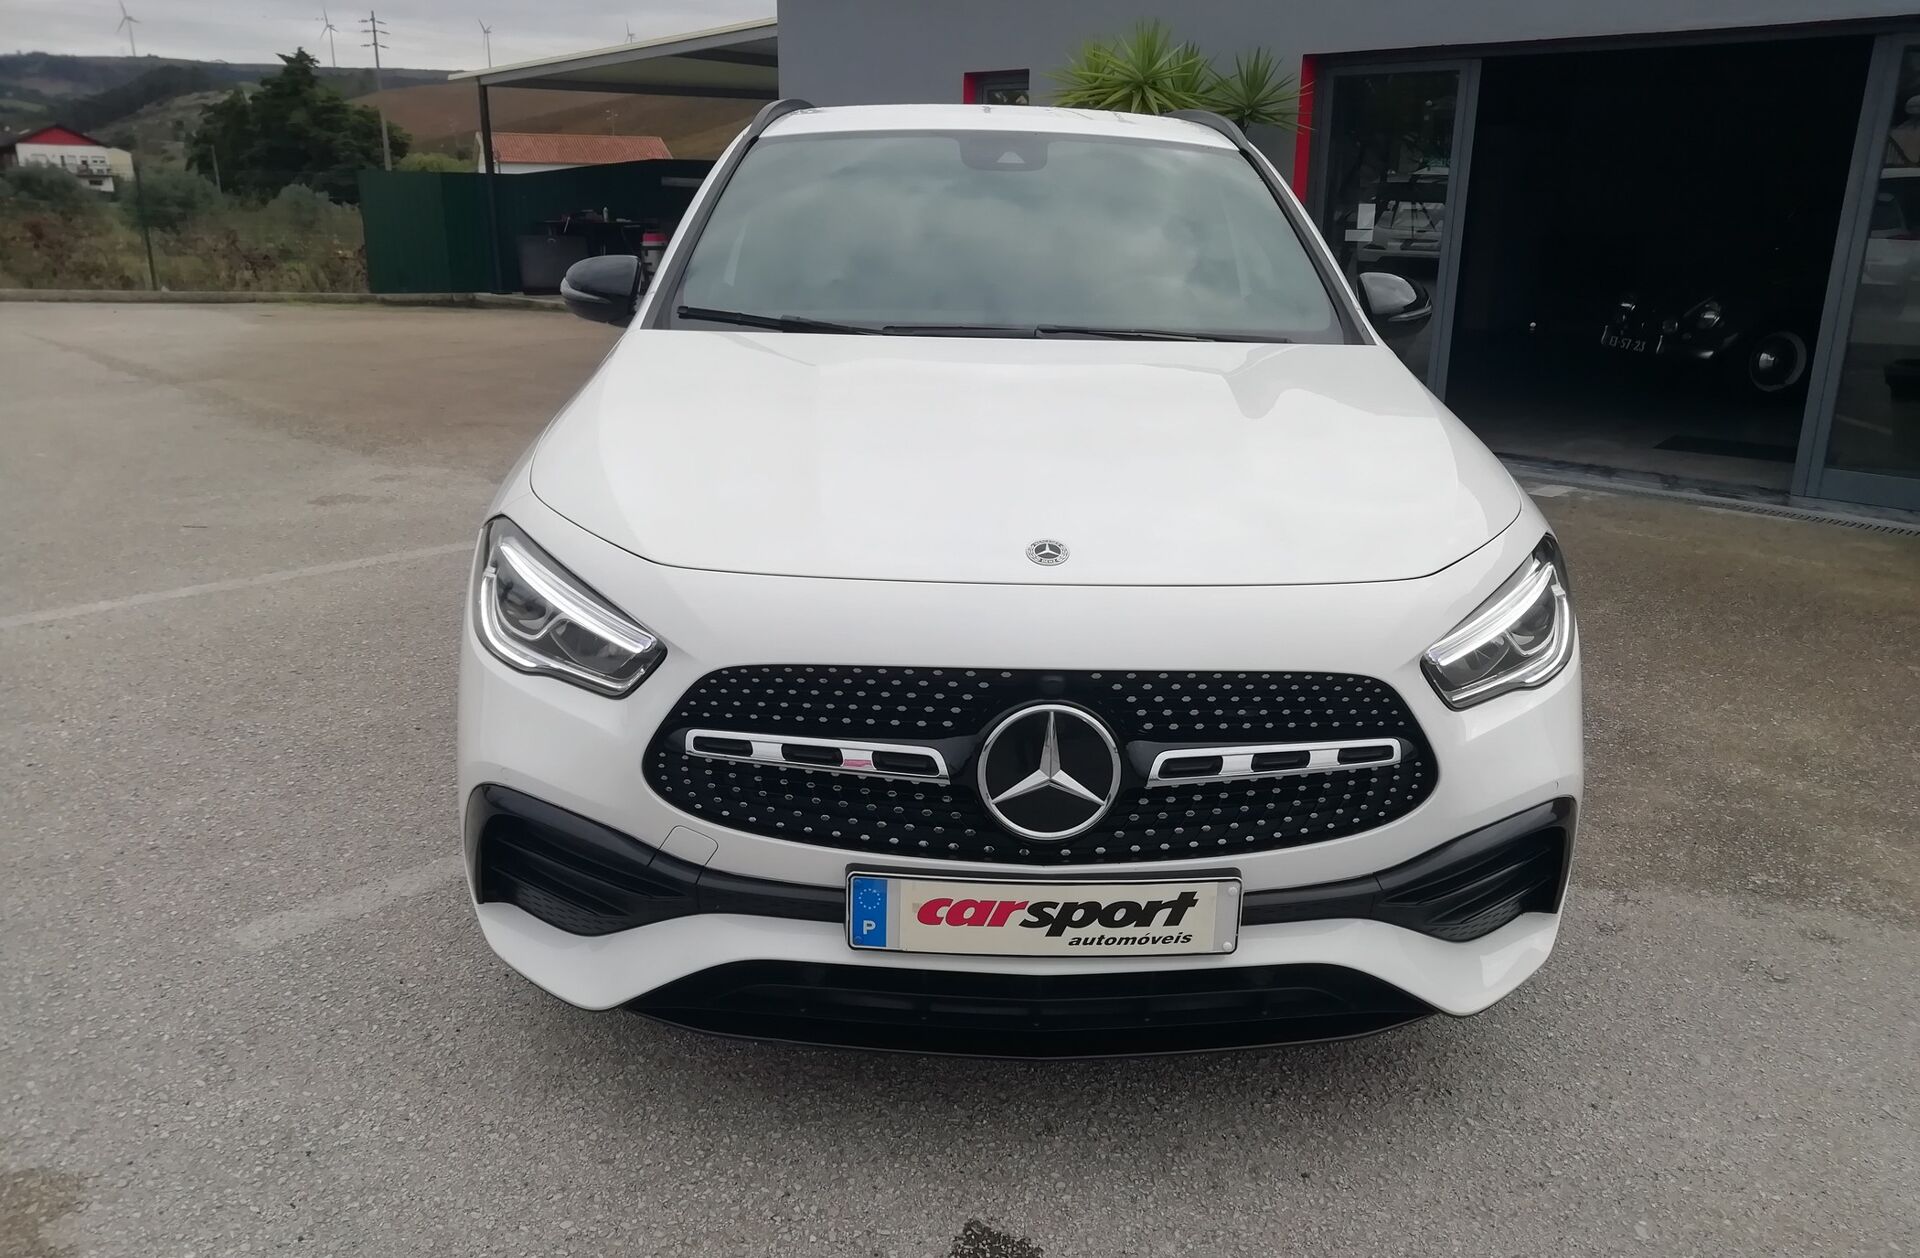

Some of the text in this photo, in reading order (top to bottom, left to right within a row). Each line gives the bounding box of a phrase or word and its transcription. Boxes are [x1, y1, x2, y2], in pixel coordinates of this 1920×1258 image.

[916, 891, 1199, 937] carsport
[863, 920, 876, 935] P
[1067, 931, 1193, 946] automóveis
